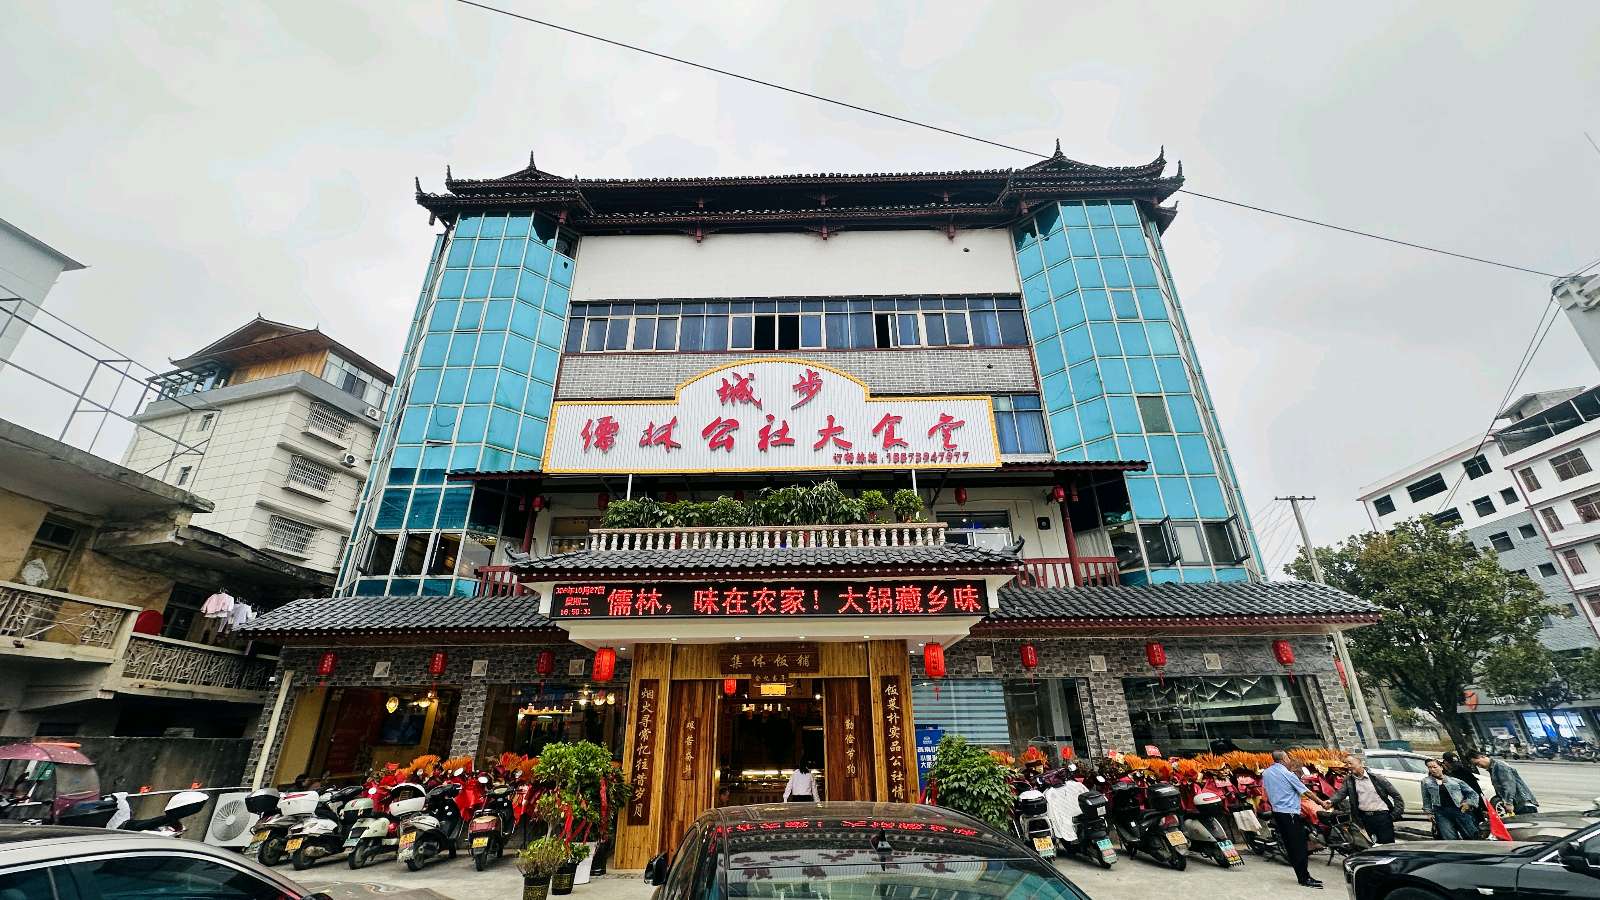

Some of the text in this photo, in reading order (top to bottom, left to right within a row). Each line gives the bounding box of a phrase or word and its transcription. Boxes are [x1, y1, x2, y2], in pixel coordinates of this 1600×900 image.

[717, 368, 823, 410] 城步
[580, 412, 967, 453] 儒林公社大食堂
[729, 653, 810, 669] 集体饭铺
[632, 687, 654, 818] 烟火寻常忆往昔岁月
[844, 718, 856, 775] 勤俭节约
[884, 684, 905, 803] 饭菜朴实品公社情
